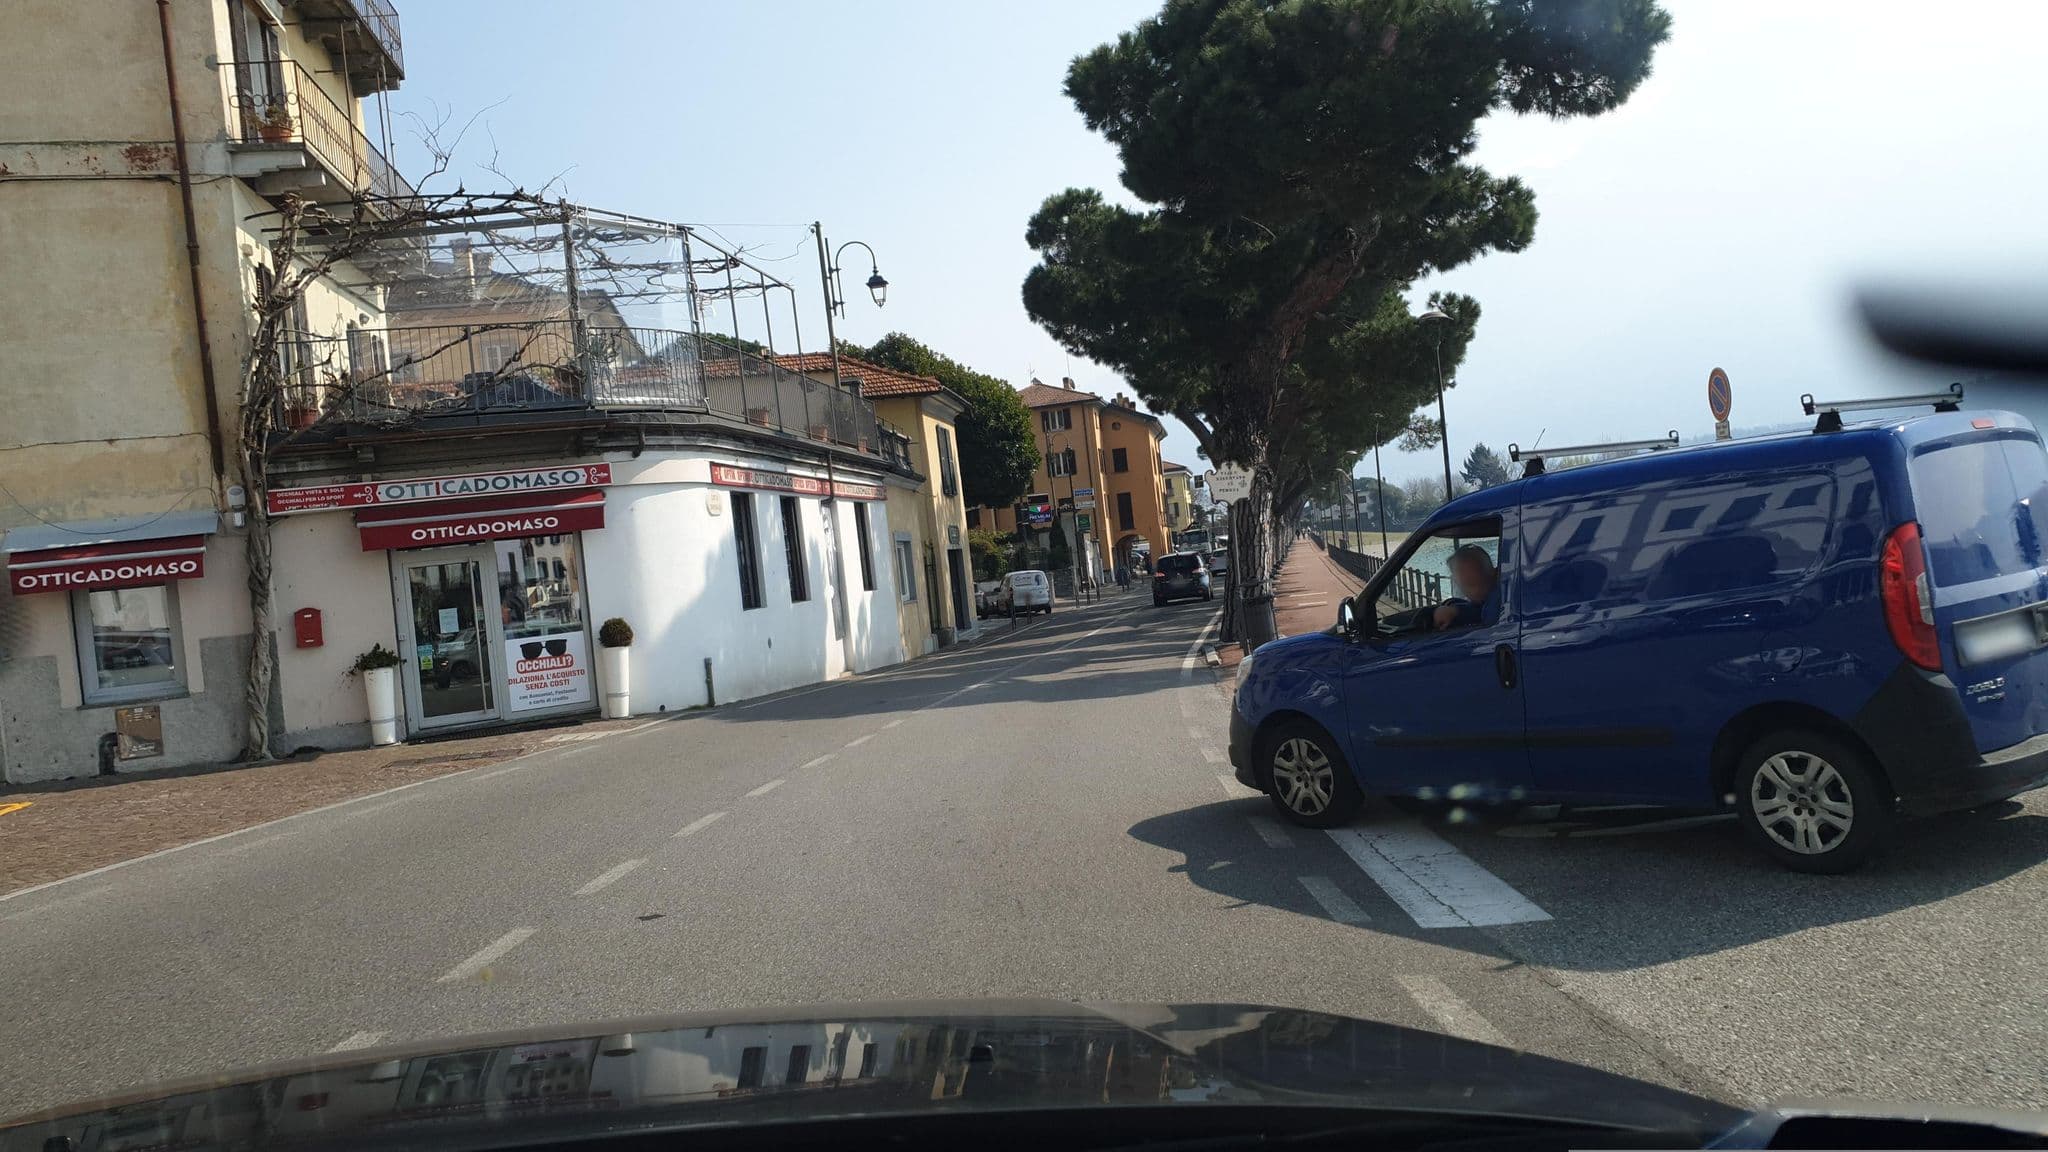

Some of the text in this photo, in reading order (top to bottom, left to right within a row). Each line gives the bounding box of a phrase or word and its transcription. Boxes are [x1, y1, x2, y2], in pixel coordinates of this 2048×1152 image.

[385, 470, 580, 500] OTTICADOMASO
[411, 516, 559, 541] OTTICADOMASO
[18, 560, 197, 588] OTTICADOMASO
[518, 656, 572, 672] OCCHIALI?
[508, 668, 585, 685] DILAZIONA L'ACQUISTO
[525, 679, 570, 690] SENZA COSTI
